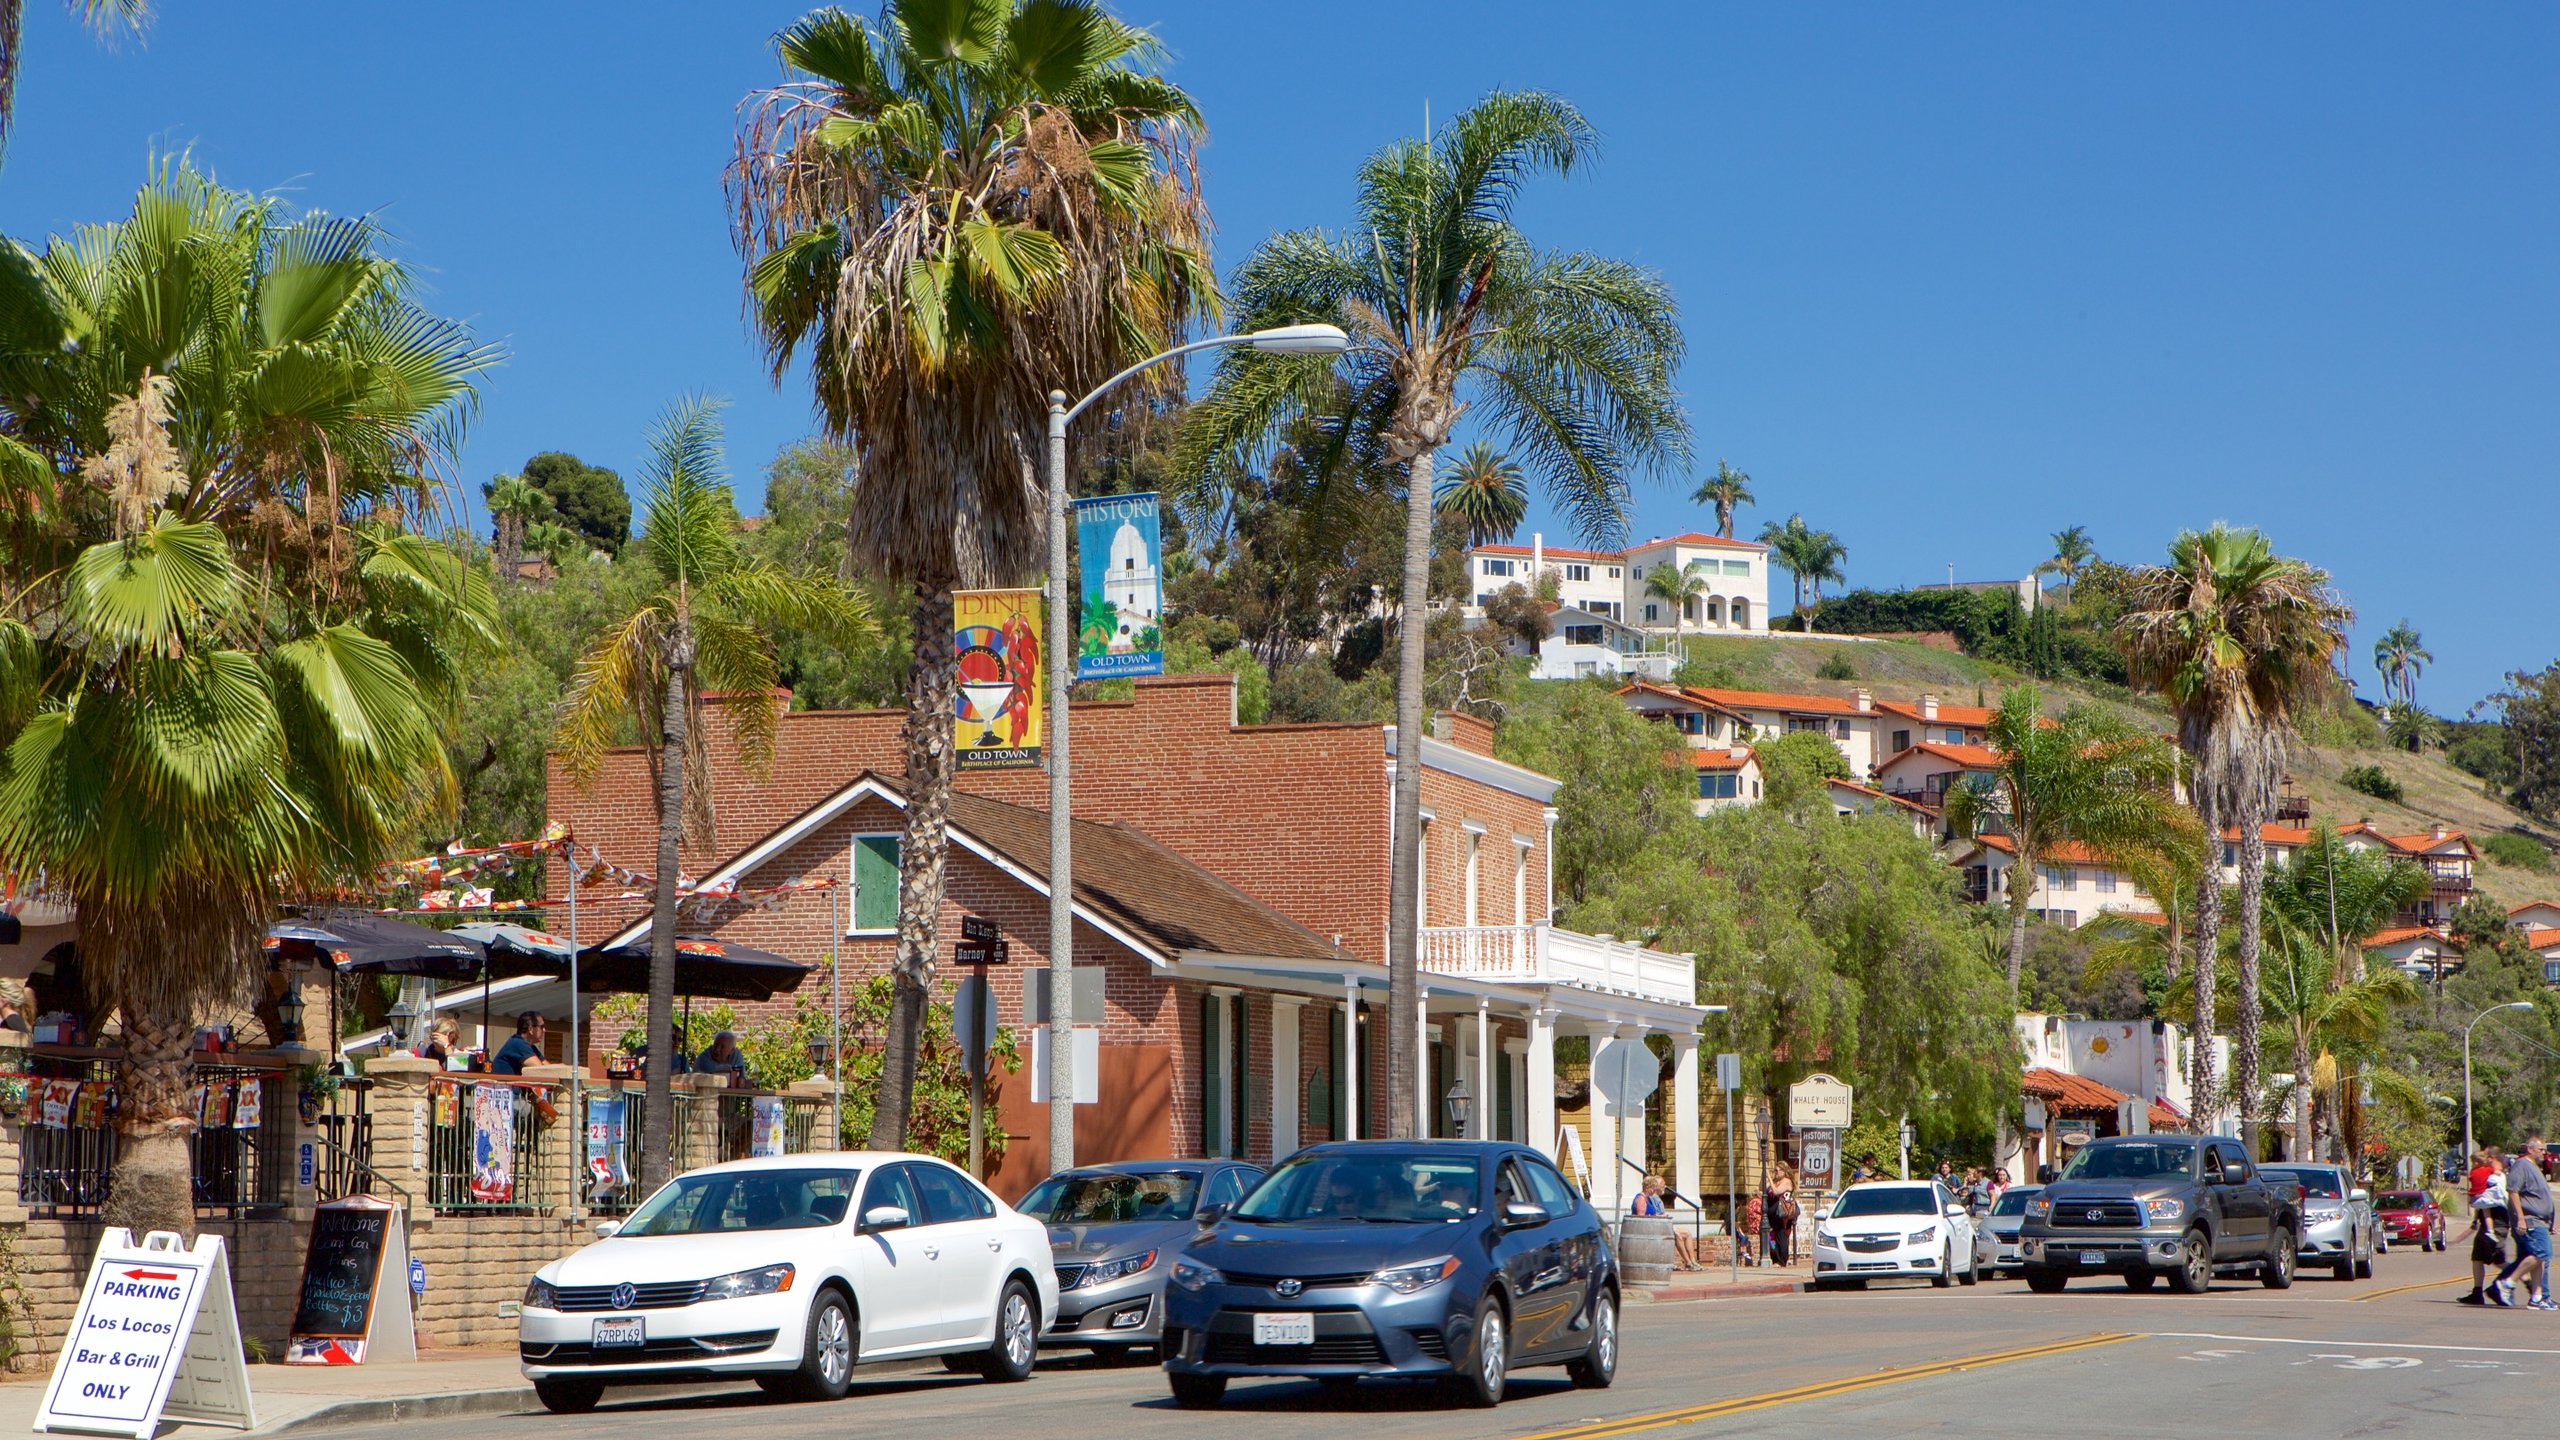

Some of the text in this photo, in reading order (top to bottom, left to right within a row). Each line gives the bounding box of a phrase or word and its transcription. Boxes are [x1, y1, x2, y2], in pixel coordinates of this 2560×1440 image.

[1077, 497, 1155, 523] HISTORY
[962, 592, 1029, 615] DINE
[1091, 654, 1150, 667] OLD TOWN
[968, 749, 1028, 760] OLD TOWN
[957, 948, 986, 962] Harney
[1793, 1096, 1846, 1105] WHALEY HOUSE
[1803, 1131, 1833, 1140] HISTORIC
[1809, 1158, 1826, 1169] 101
[1805, 1177, 1827, 1186] ROUTE
[321, 1214, 380, 1233] Welcome
[351, 1236, 369, 1250] Con
[103, 1281, 181, 1300] PARKING
[341, 1305, 363, 1328] $3
[87, 1314, 172, 1335] Los Locos
[597, 1328, 640, 1343] 6ZRP169
[76, 1349, 160, 1369] Bar & Grill
[82, 1382, 130, 1400] ONLY
